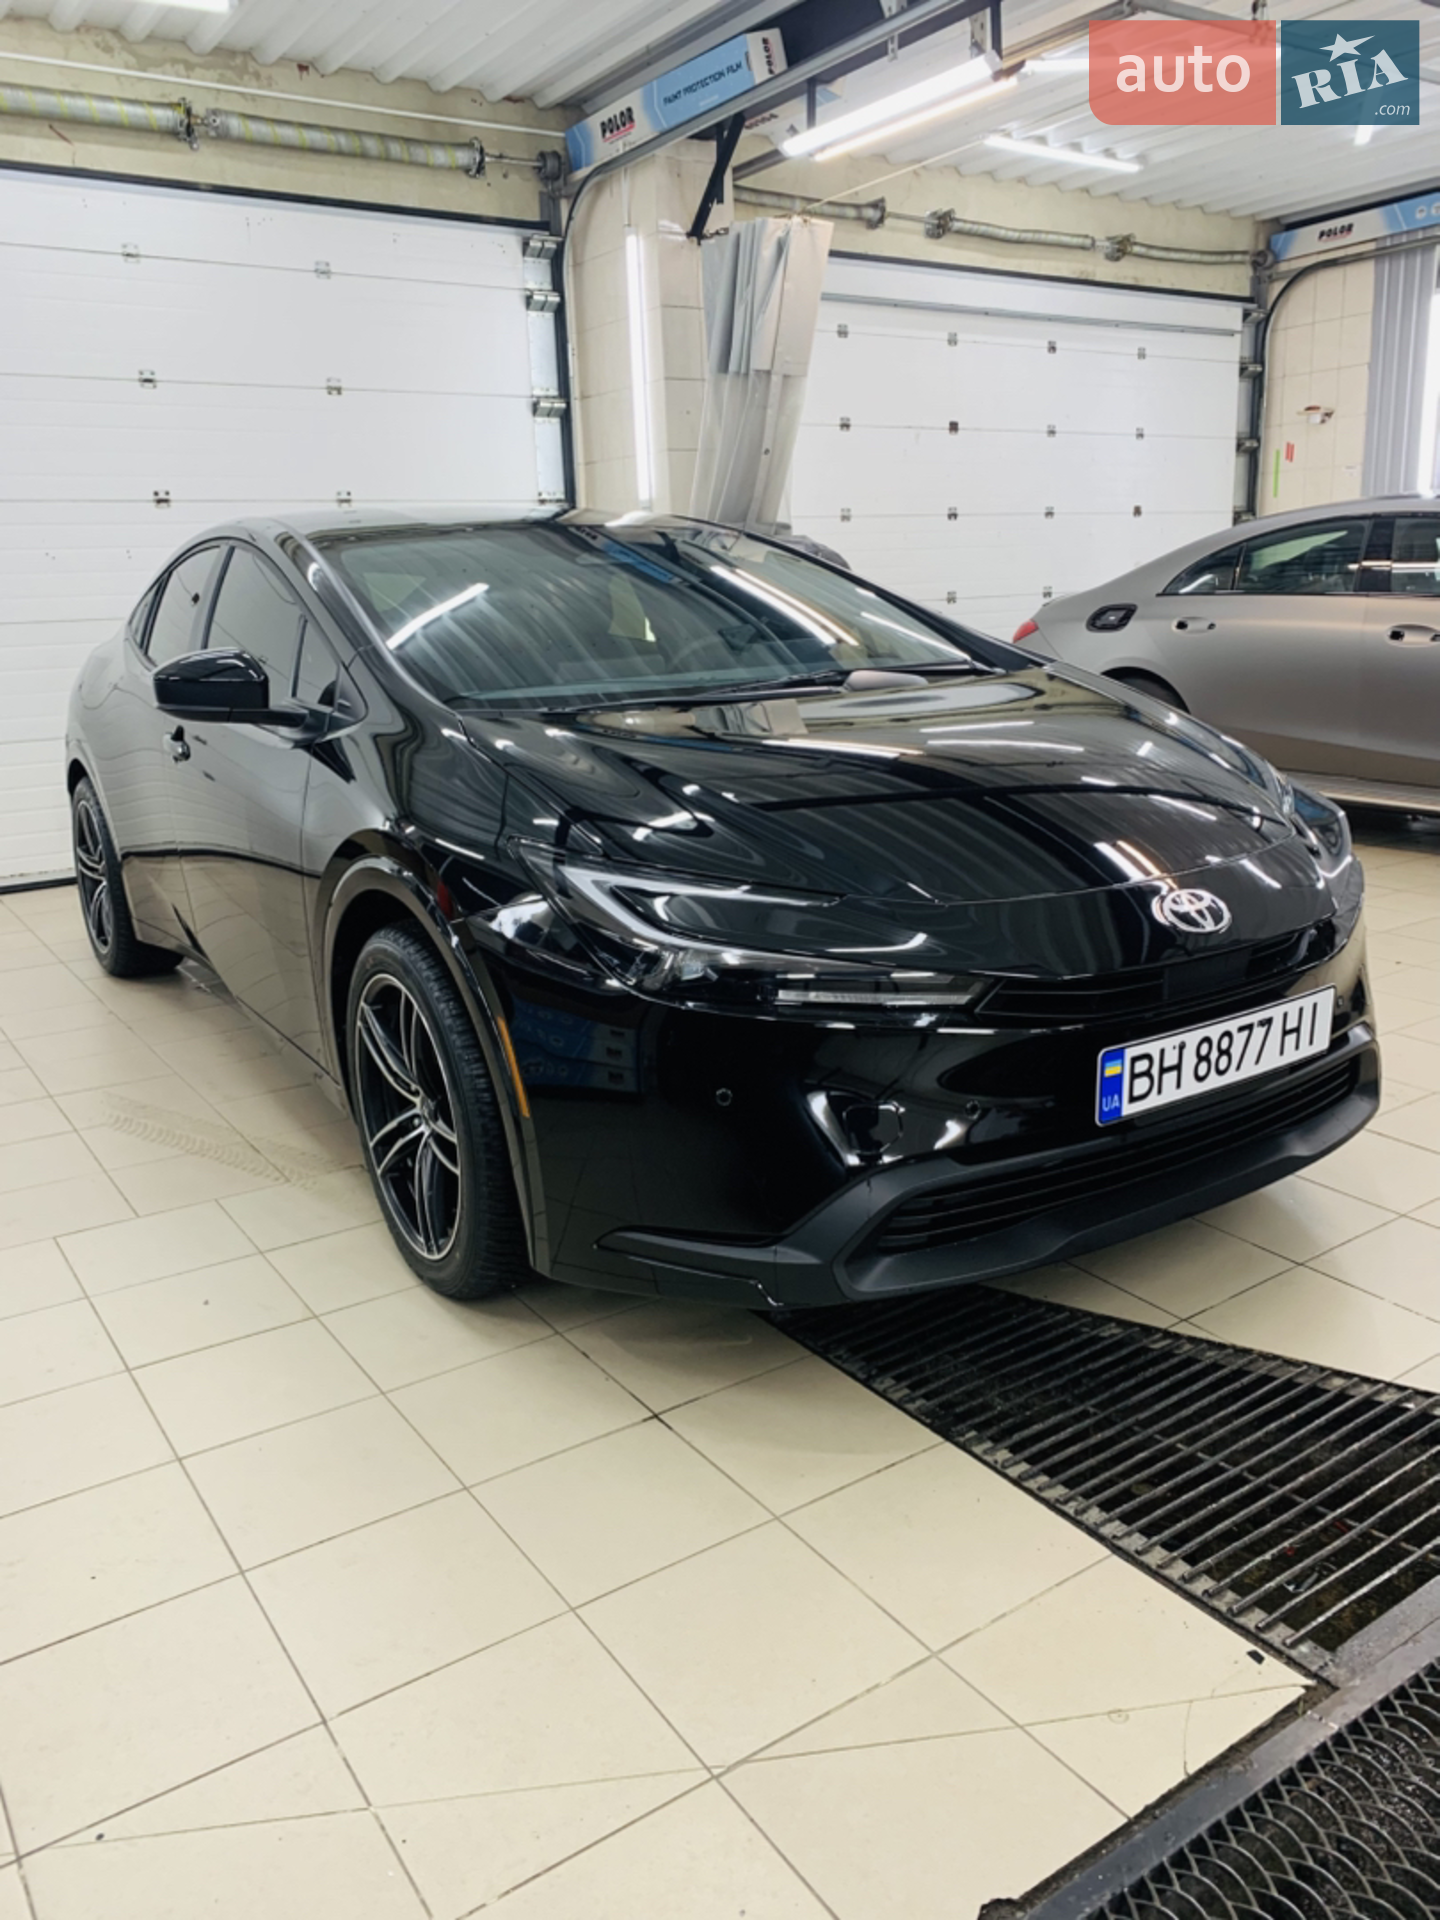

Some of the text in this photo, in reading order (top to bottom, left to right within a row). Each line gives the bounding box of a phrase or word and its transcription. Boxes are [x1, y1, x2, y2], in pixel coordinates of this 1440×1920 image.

[762, 37, 776, 75] POLOR
[663, 89, 682, 106] PAINT
[683, 69, 726, 96] PROTECTION
[726, 60, 743, 77] FILM
[600, 106, 635, 139] POLOR
[1318, 223, 1354, 241] POLOR
[1128, 1002, 1318, 1104] BH 8877 HI
[1102, 1094, 1120, 1112] UA
